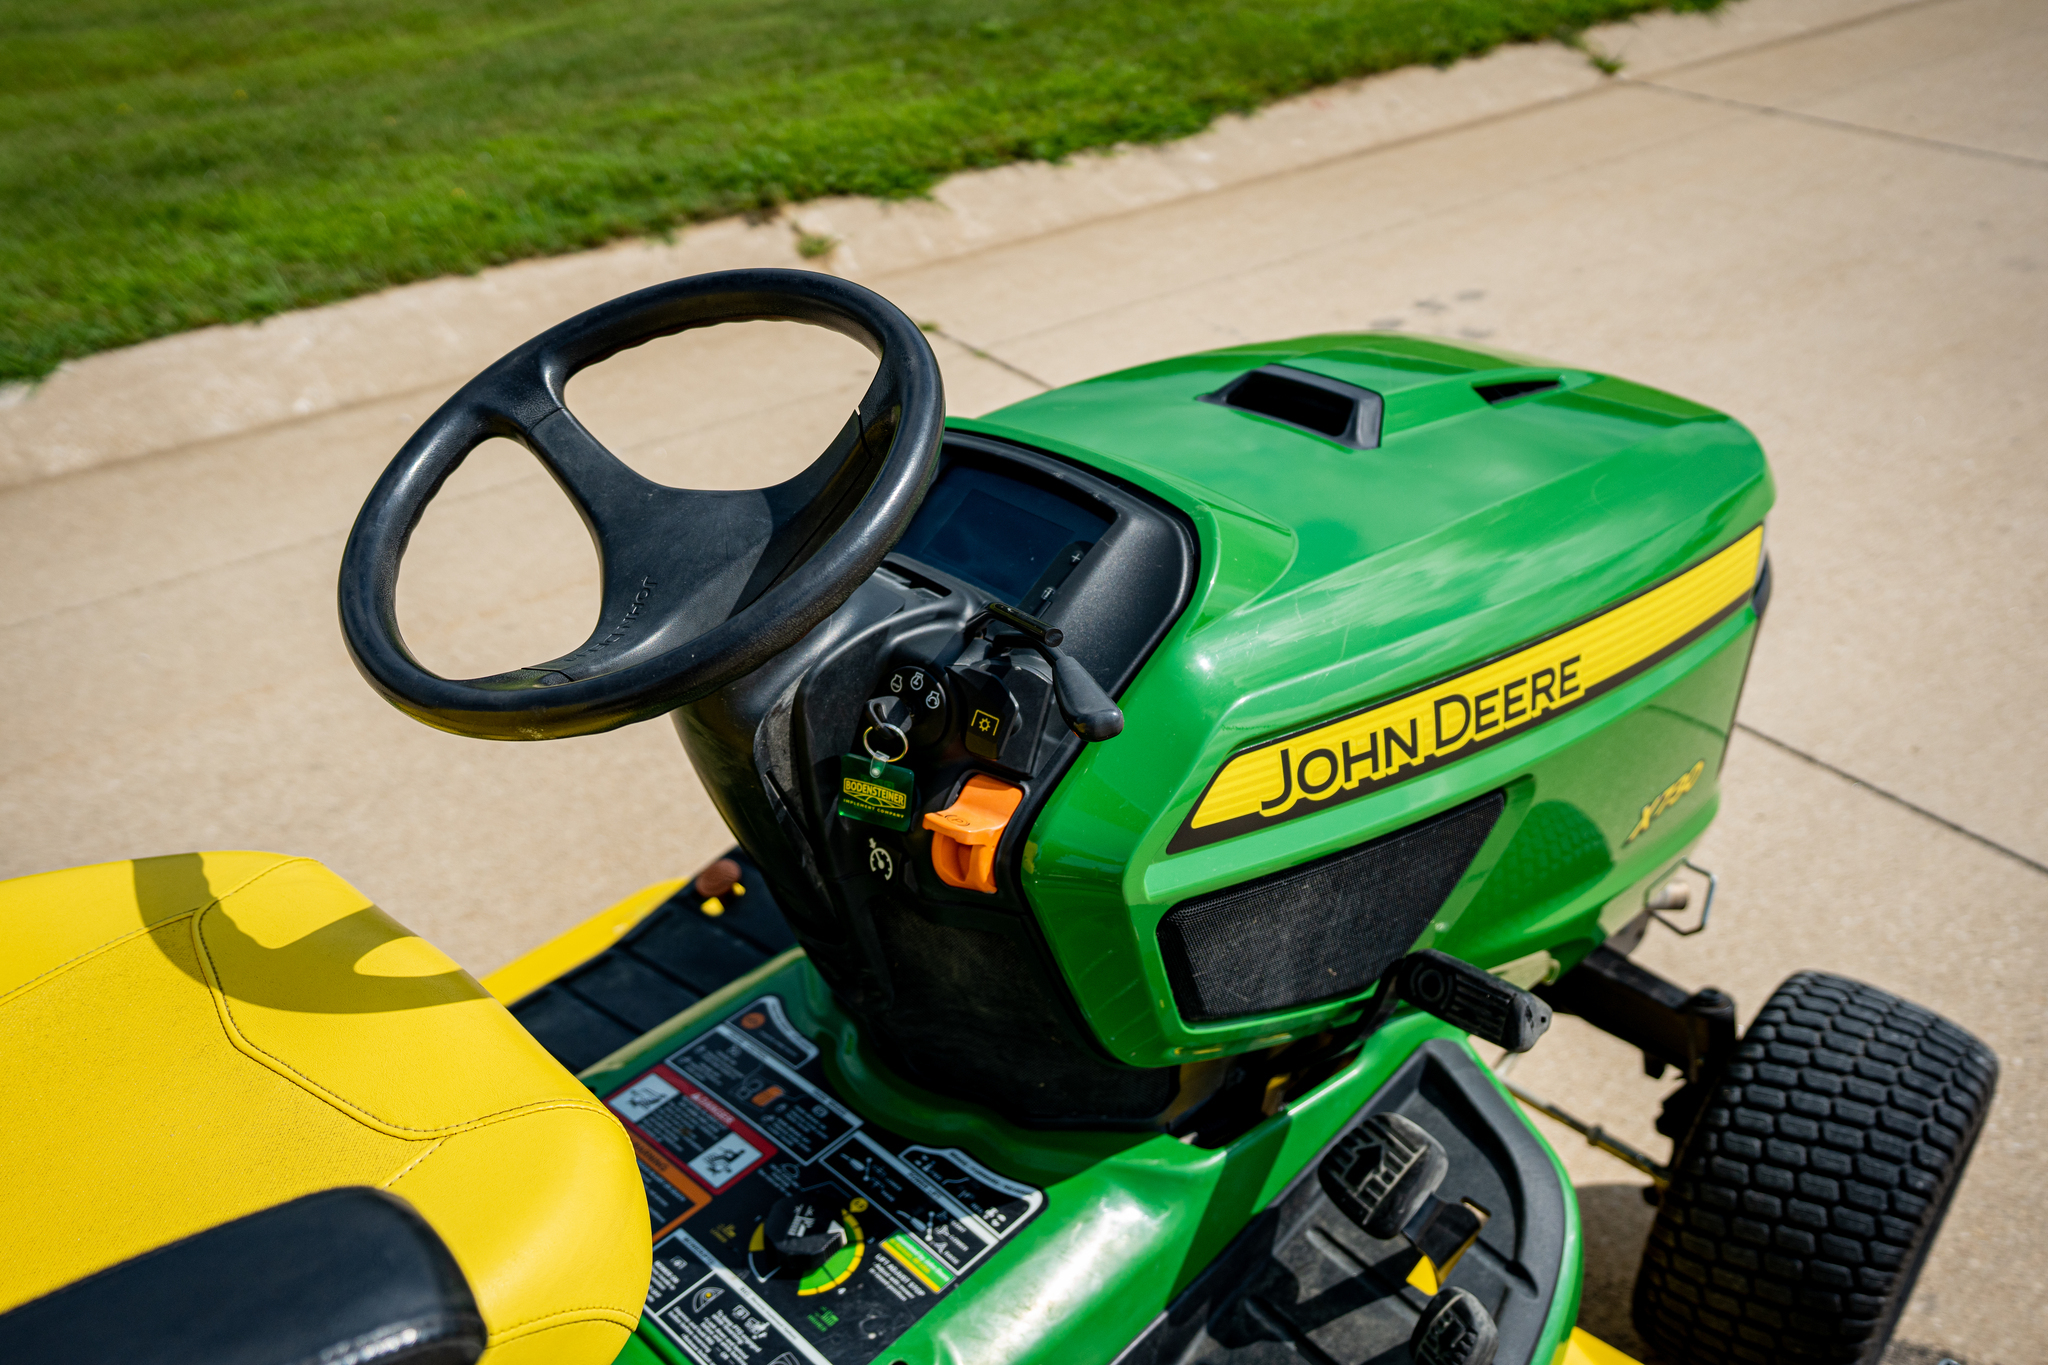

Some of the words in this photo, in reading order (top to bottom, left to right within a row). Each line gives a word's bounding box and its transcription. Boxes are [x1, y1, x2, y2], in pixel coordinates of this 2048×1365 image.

[1261, 717, 1420, 810] JOHN
[1433, 654, 1585, 750] DEERE
[846, 780, 904, 805] BODENSTEINER
[843, 798, 875, 811] IMPLEMENT
[876, 808, 904, 819] COMPANY
[698, 1094, 734, 1125] DANGER
[875, 1253, 891, 1266] LIFT
[886, 1263, 911, 1284] ADJUST
[907, 1281, 926, 1297] STOP
